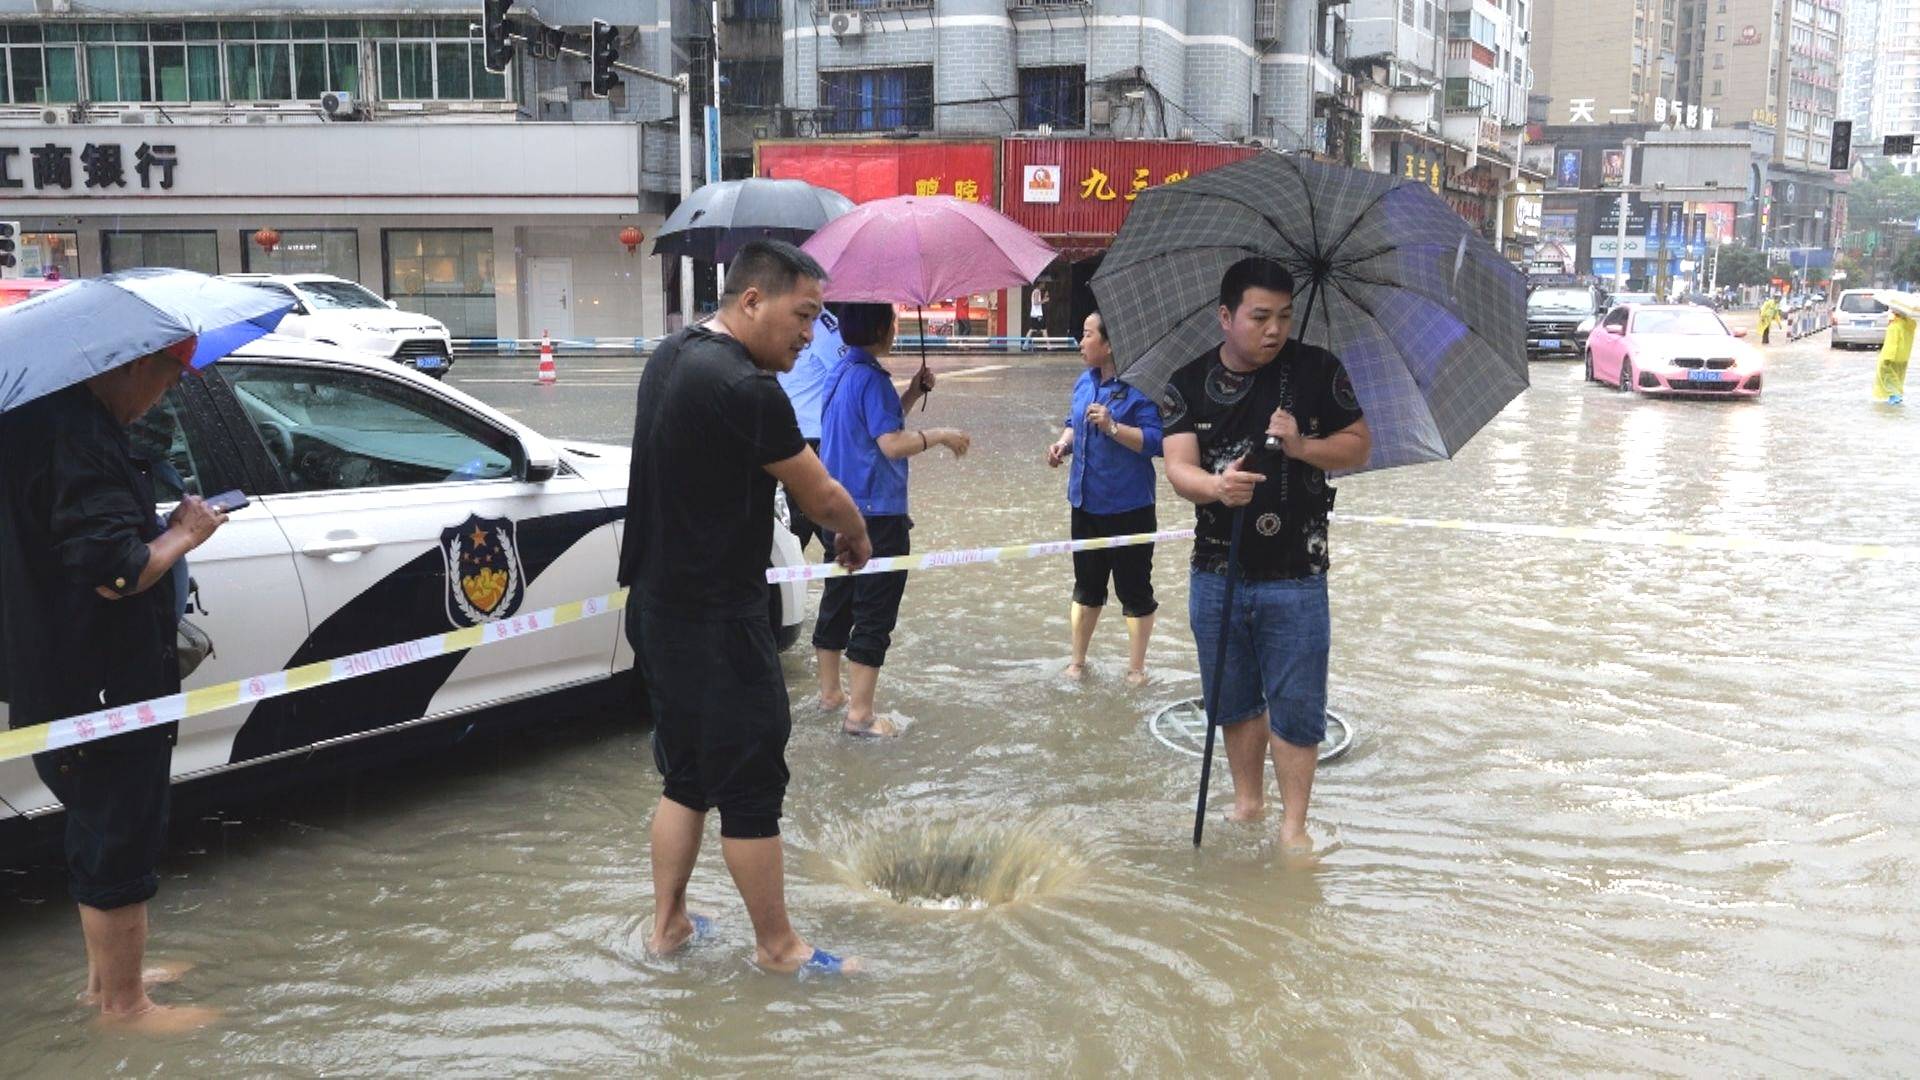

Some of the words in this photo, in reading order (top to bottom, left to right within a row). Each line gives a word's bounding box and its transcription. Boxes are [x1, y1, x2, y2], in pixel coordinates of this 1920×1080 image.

[0, 142, 178, 190] 工商银行
[1080, 167, 1189, 200] 九三
